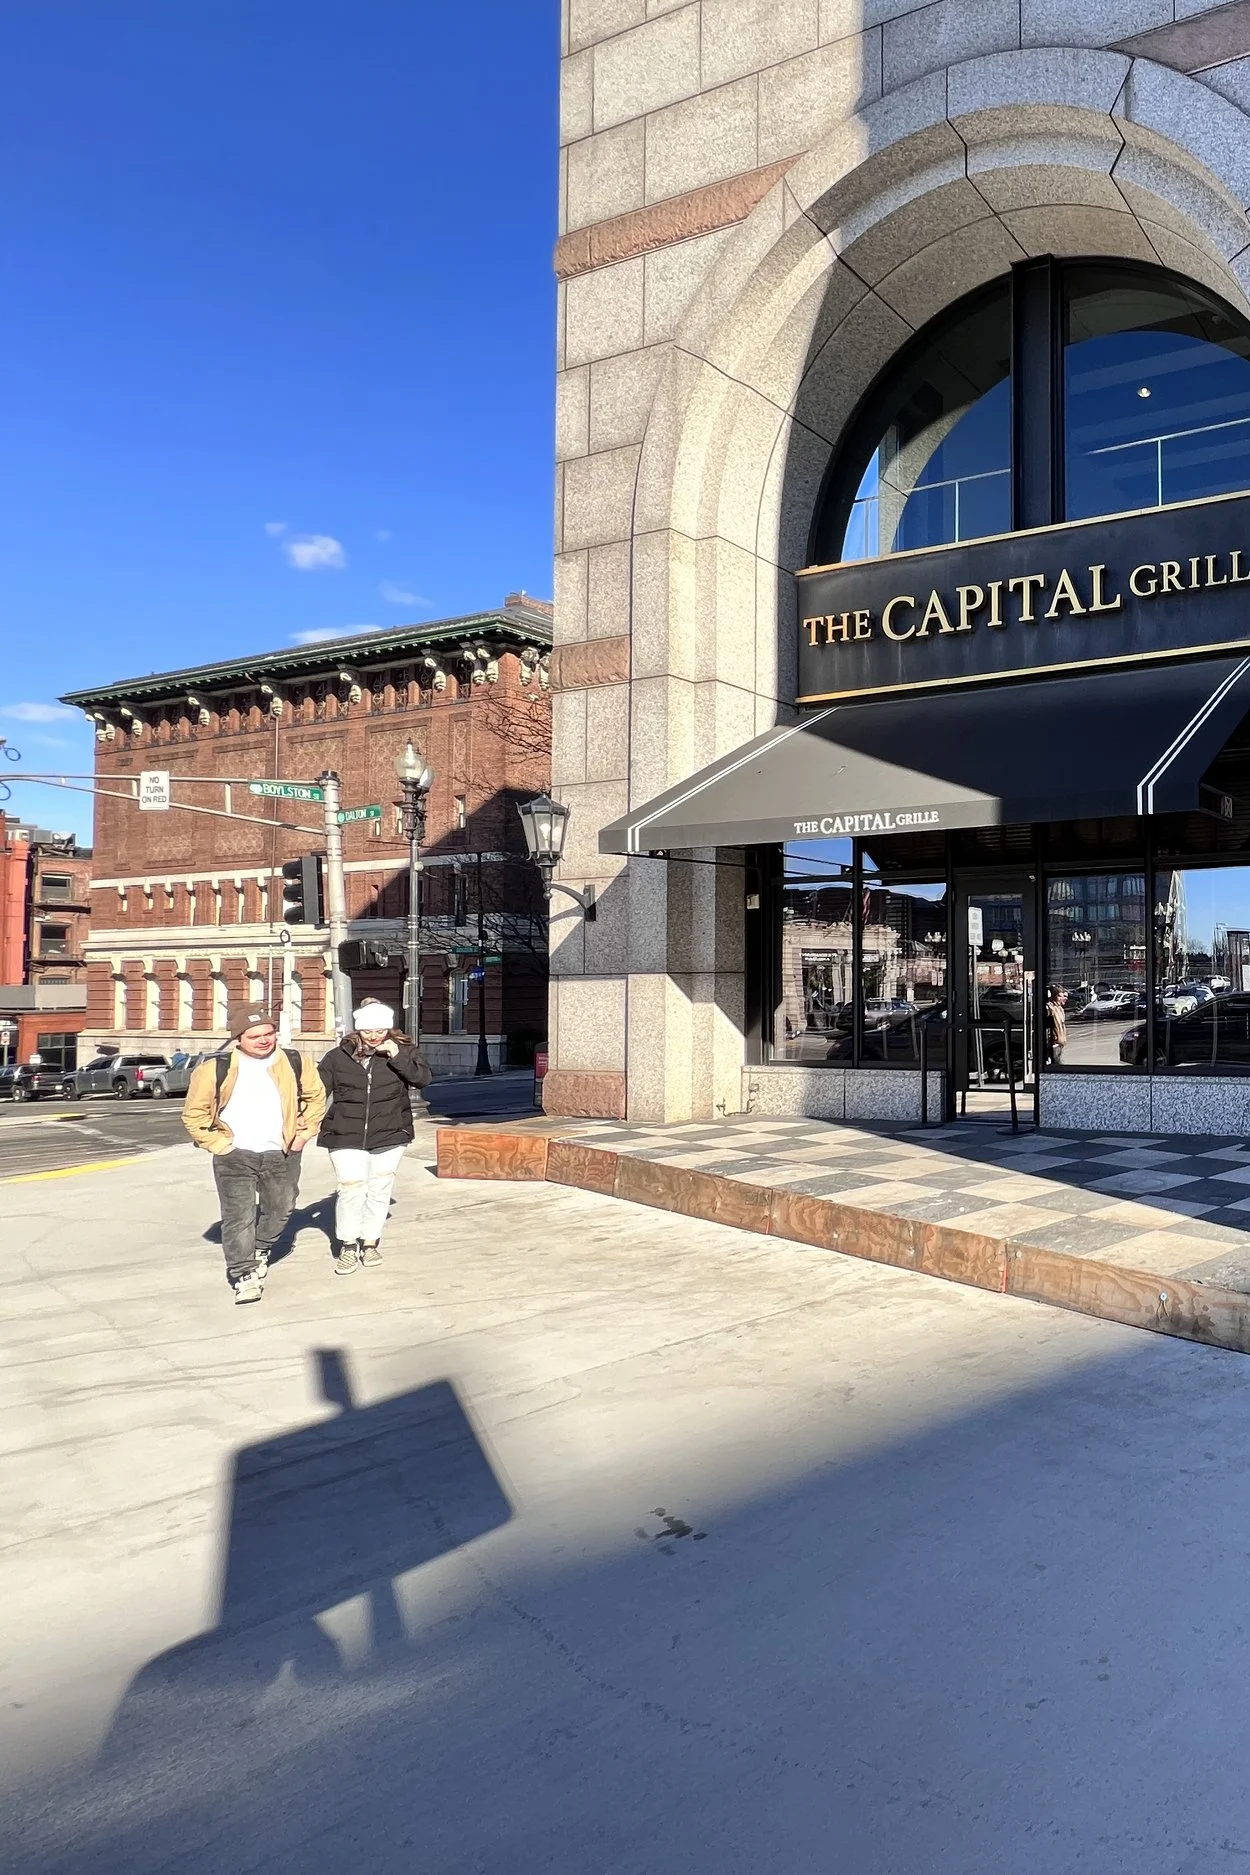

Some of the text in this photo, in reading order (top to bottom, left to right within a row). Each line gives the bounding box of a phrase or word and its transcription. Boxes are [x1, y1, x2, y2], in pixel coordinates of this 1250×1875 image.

[803, 609, 872, 647] THE
[881, 564, 1121, 641] CAPITAL
[149, 776, 160, 784] NO
[145, 786, 164, 794] TURN
[262, 783, 312, 799] BOYLSTON
[141, 795, 167, 804] ON RED
[345, 808, 367, 821] DALTON
[793, 810, 940, 834] THE CAPITAL GRILLE
